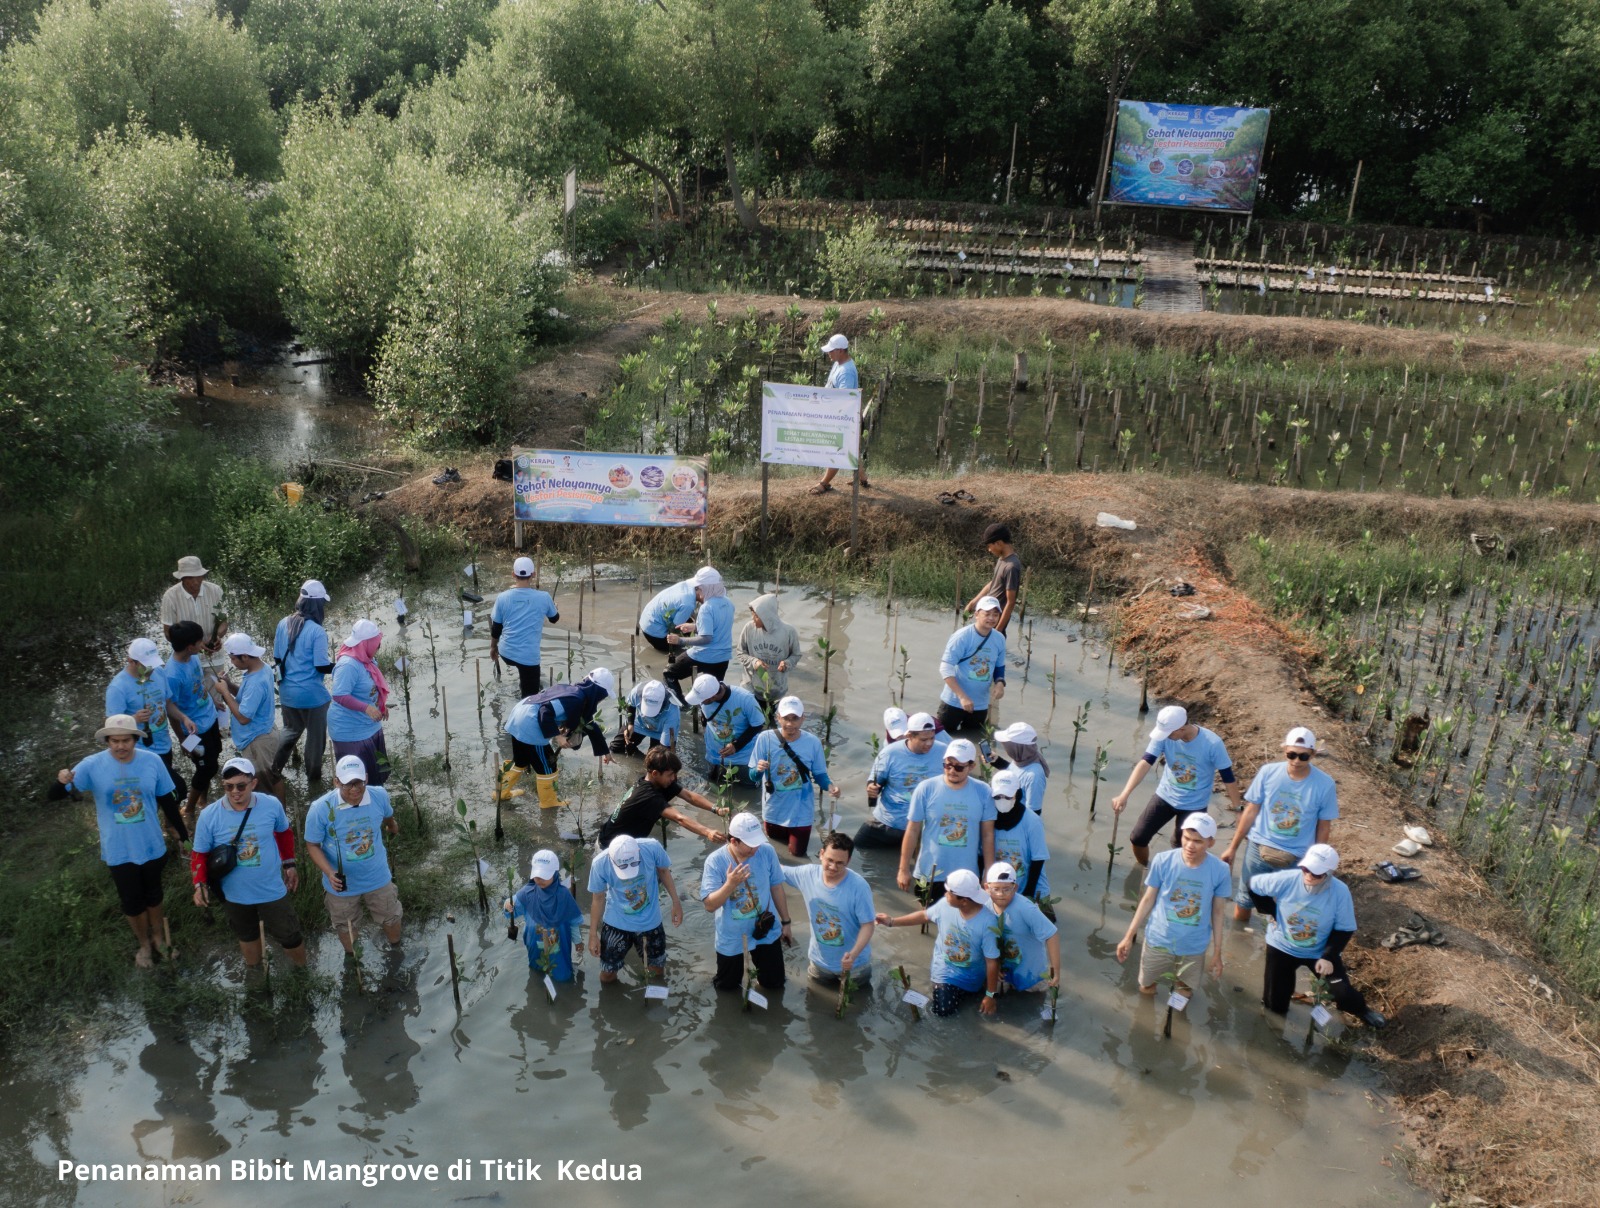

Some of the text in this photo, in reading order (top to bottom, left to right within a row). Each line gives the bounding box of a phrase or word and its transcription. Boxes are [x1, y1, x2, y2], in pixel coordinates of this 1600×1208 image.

[1147, 129, 1234, 140] Sehat Nelayannya
[1154, 140, 1225, 149] Lestari Pesisirnya
[516, 478, 612, 494] Sehat Nelayannya
[525, 491, 555, 503] Lestari
[557, 490, 603, 503] Pesisirnya
[753, 642, 783, 654] HOLIDAY
